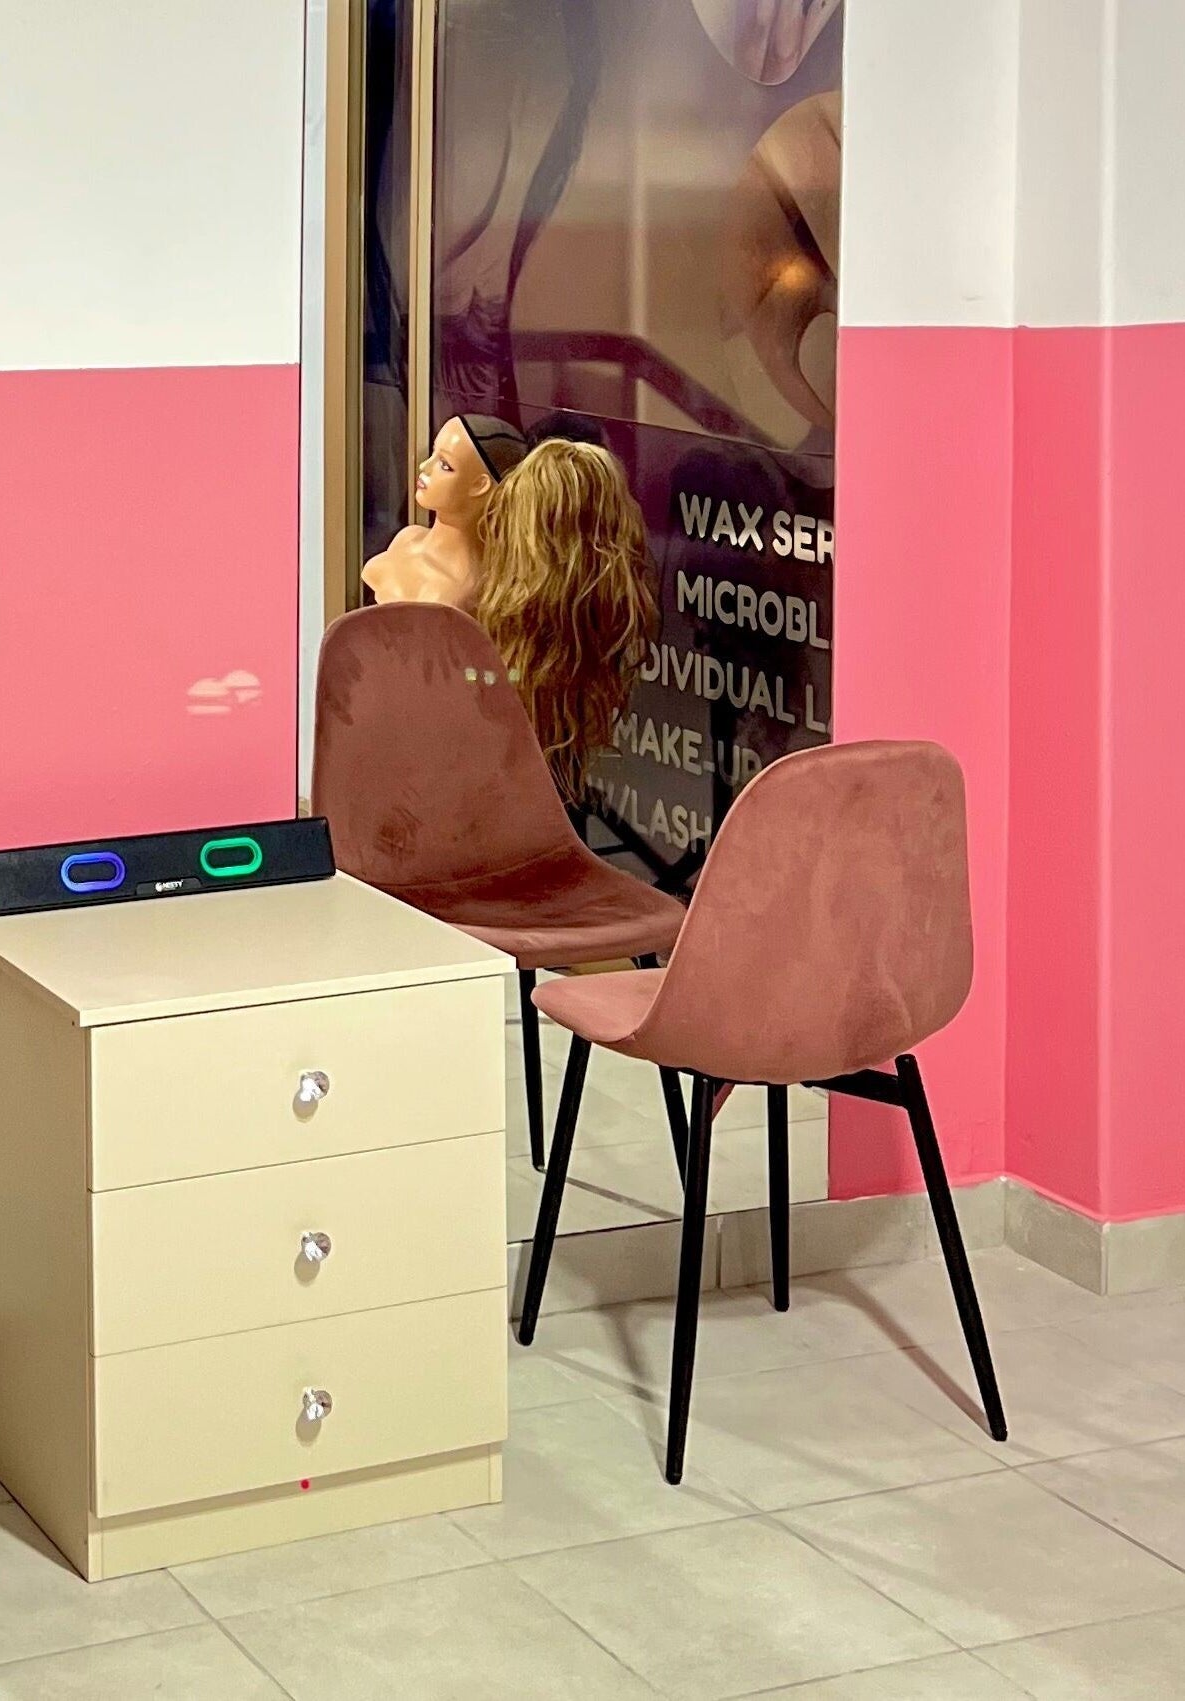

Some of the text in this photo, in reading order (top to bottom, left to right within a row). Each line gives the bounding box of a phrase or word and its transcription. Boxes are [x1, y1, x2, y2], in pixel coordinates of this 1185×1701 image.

[679, 492, 834, 563] WAX SER
[677, 570, 830, 649] MICROBL
[639, 641, 795, 724] DIVIDUAL
[612, 707, 764, 787] MAKE-UP
